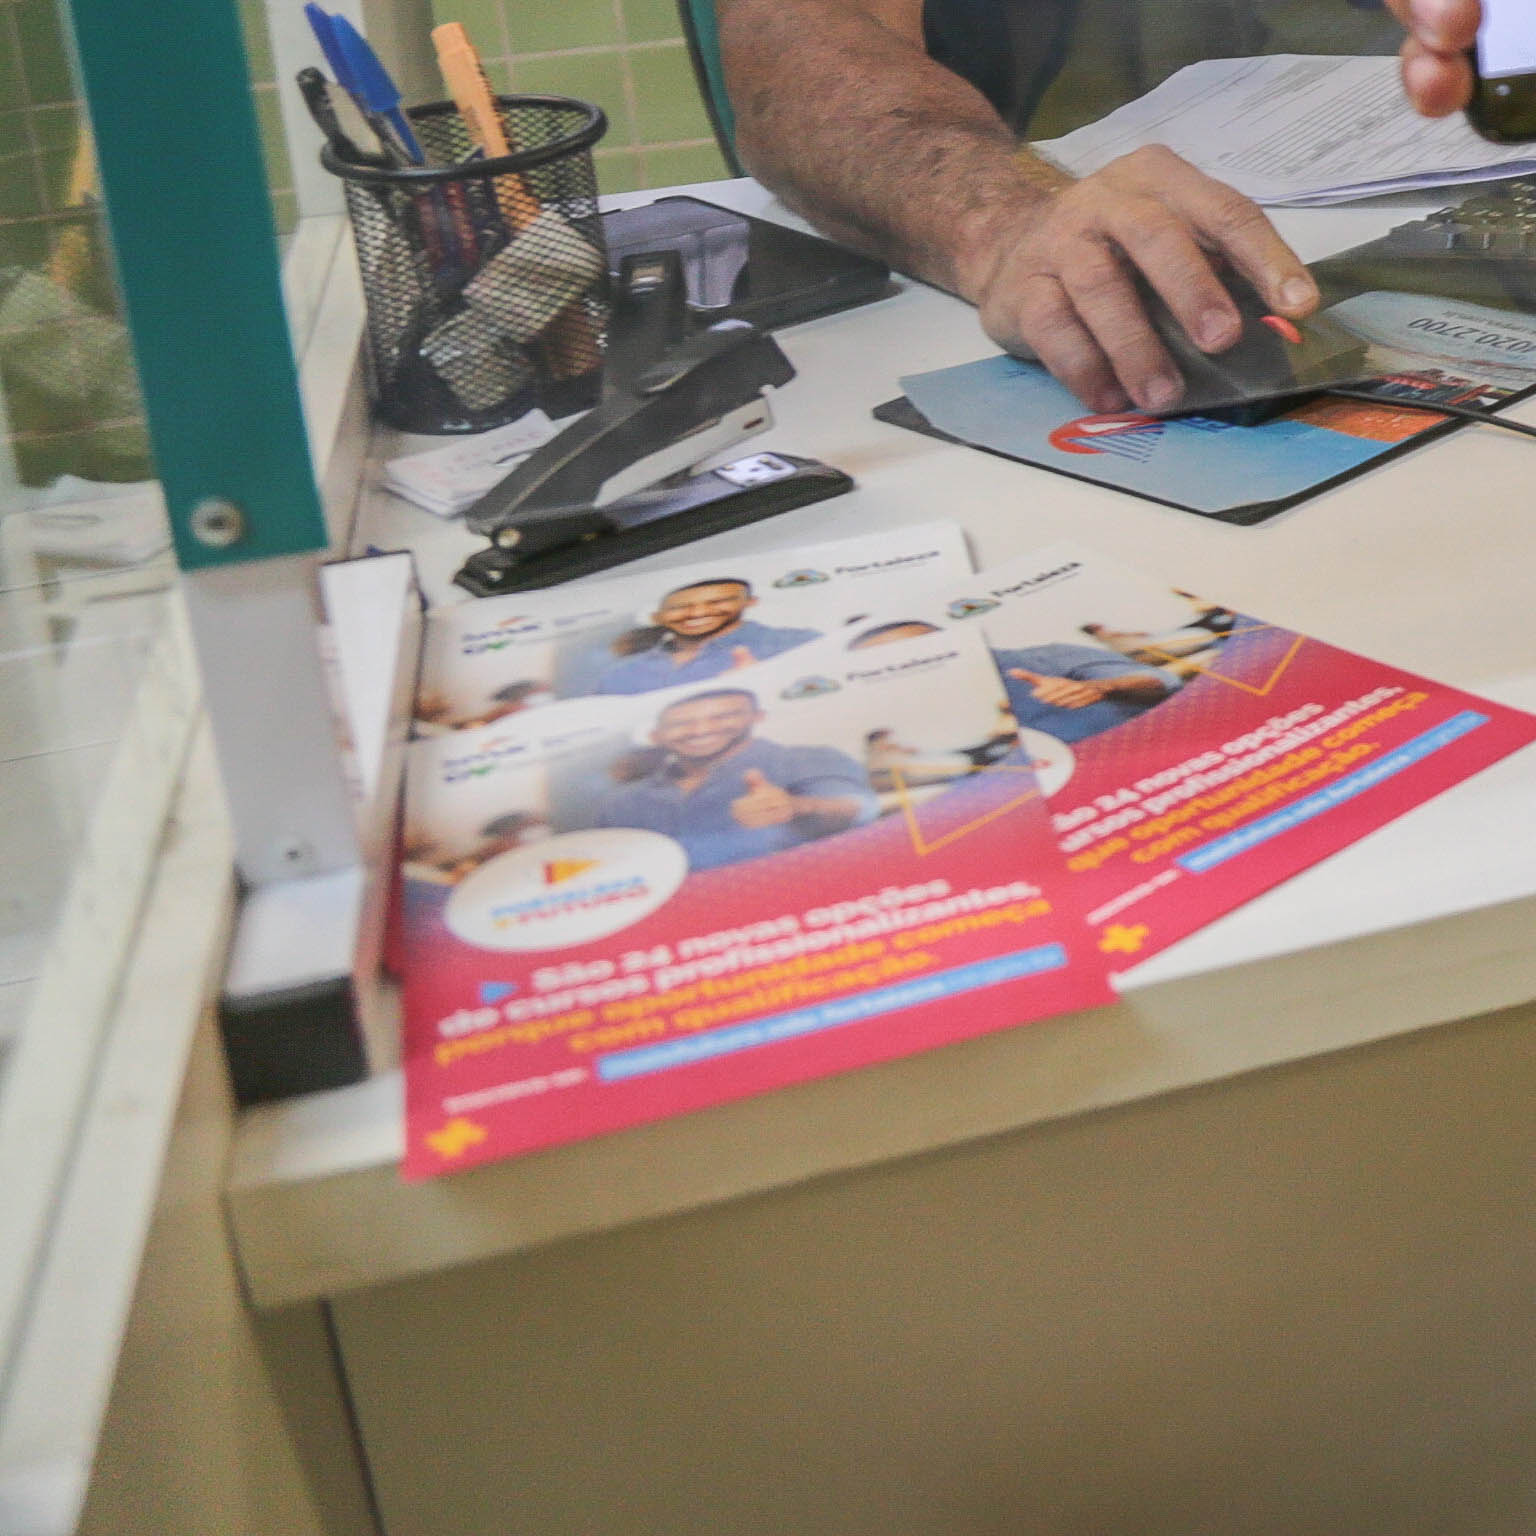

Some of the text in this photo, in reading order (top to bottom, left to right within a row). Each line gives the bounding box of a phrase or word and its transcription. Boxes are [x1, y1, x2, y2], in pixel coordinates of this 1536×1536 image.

[1134, 751, 1226, 793] novas
[676, 914, 799, 961] novas
[503, 973, 651, 1022] cursos
